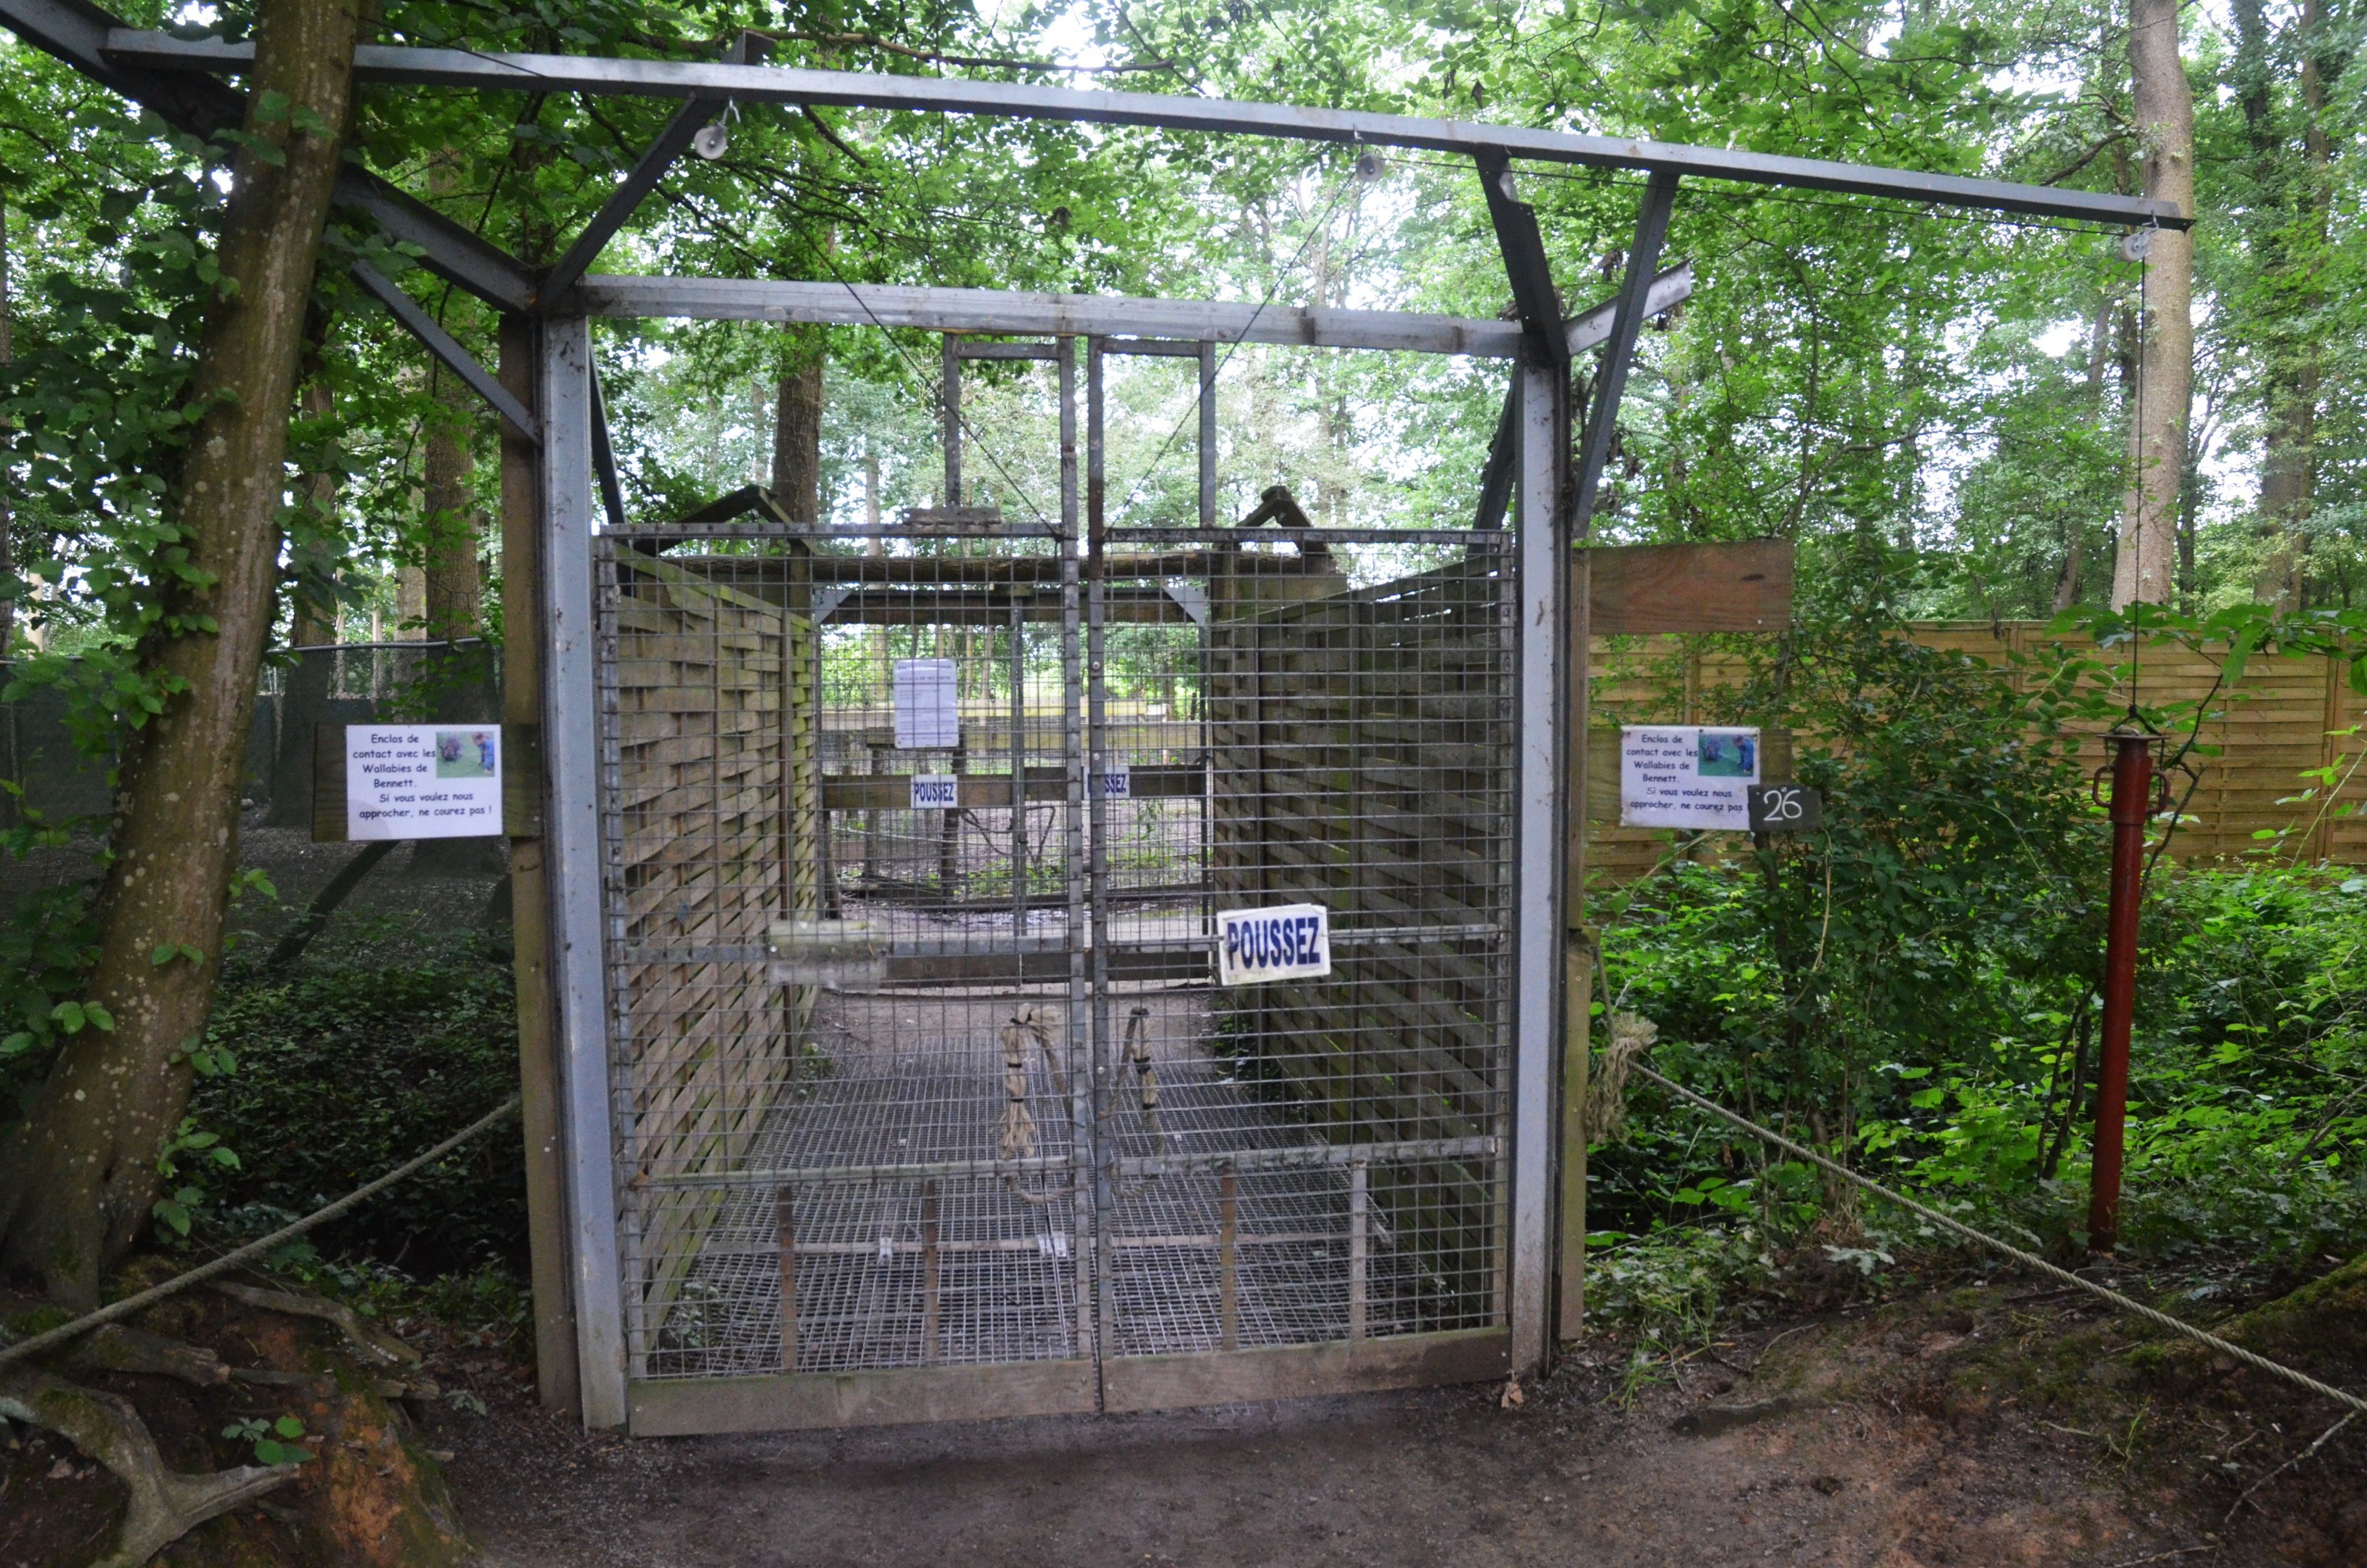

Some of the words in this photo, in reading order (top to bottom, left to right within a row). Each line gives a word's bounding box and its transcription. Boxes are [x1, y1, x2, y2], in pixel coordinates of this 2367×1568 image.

[371, 734, 403, 743] Enclos
[407, 733, 420, 743] de
[1641, 735, 1669, 743] Enclos
[1672, 735, 1683, 743] de
[353, 749, 391, 759] contact
[396, 750, 418, 759] avec
[422, 748, 436, 758] les
[1686, 748, 1698, 757] les
[362, 764, 412, 773] Wallabies
[416, 764, 428, 772] de
[1634, 761, 1676, 769] Wallabies
[1679, 761, 1690, 770] de
[374, 779, 417, 788] Bennett.
[1643, 774, 1680, 783] Bennett.
[914, 781, 954, 802] POUSSEZ
[379, 793, 390, 803] Si
[420, 793, 449, 801] voulez
[1630, 801, 1677, 810] approcher,
[1728, 804, 1743, 812] pas
[1763, 789, 1802, 822] 26
[359, 809, 414, 820] approcher,
[470, 807, 485, 817] pas
[1227, 916, 1320, 971] POUSSEZ
